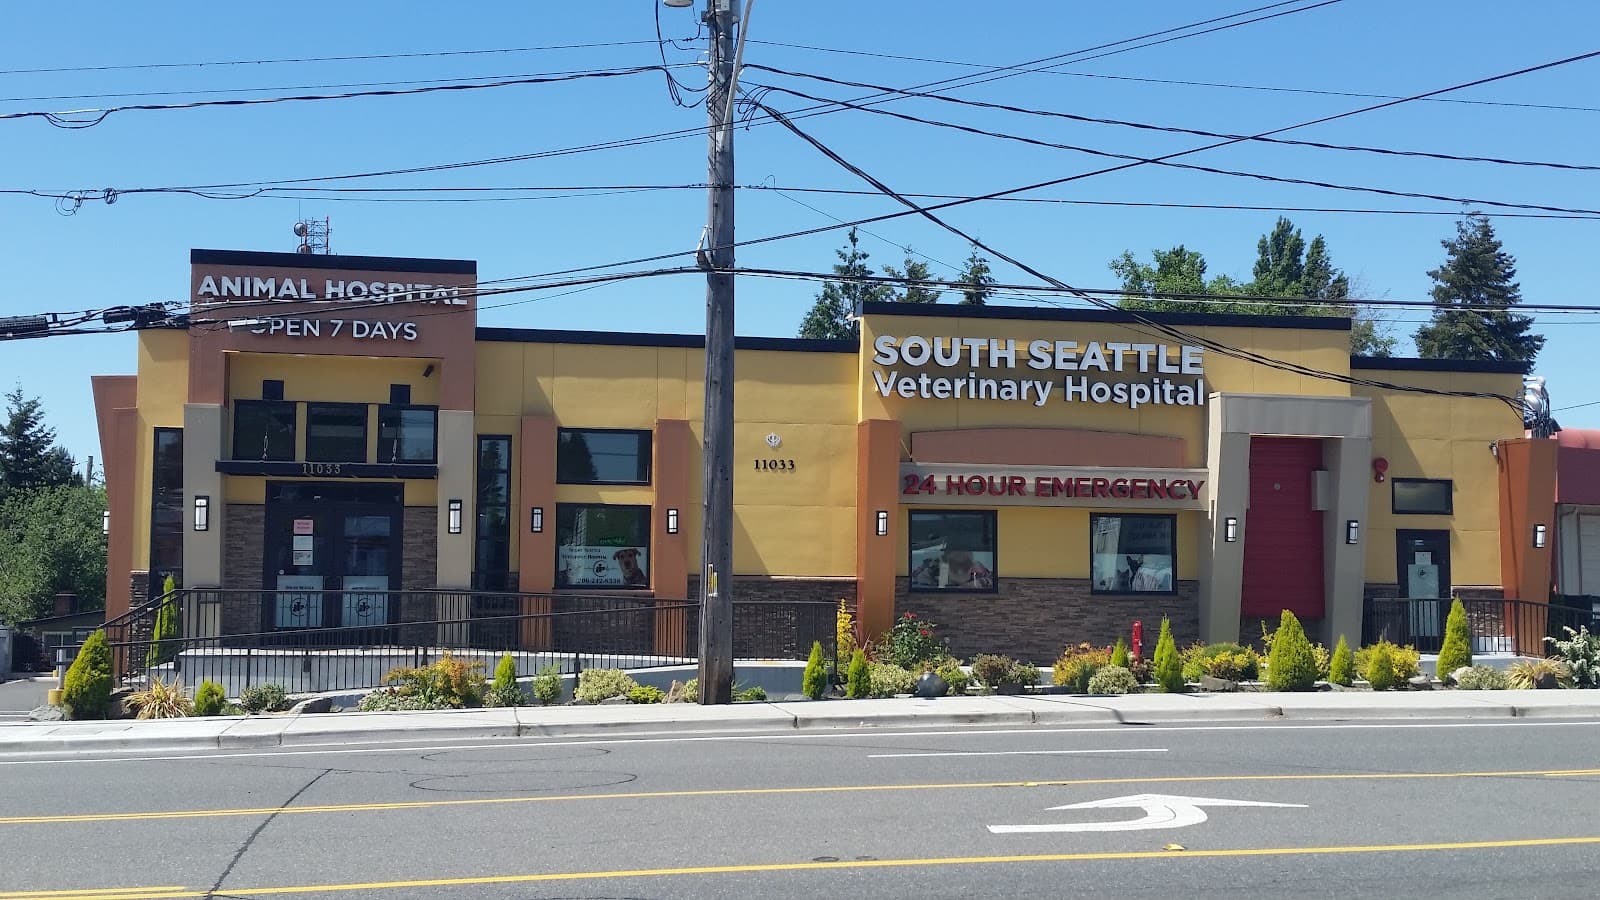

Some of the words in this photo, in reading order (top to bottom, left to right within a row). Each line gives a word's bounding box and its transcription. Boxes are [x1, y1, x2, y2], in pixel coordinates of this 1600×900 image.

[198, 275, 316, 299] ANIMAL
[324, 279, 468, 306] HOSPITAL
[330, 320, 343, 337] 7
[352, 321, 418, 341] DAYS
[873, 335, 1016, 368] SOUTH
[1028, 340, 1204, 373] SEATTLE
[873, 371, 1053, 407] Veterinary
[1064, 376, 1204, 409] Hospital
[302, 463, 341, 474] 11033
[754, 459, 795, 471] 11033
[903, 474, 937, 495] 24
[946, 475, 1026, 497] HOUR
[1035, 477, 1205, 500] EMERGENCY
